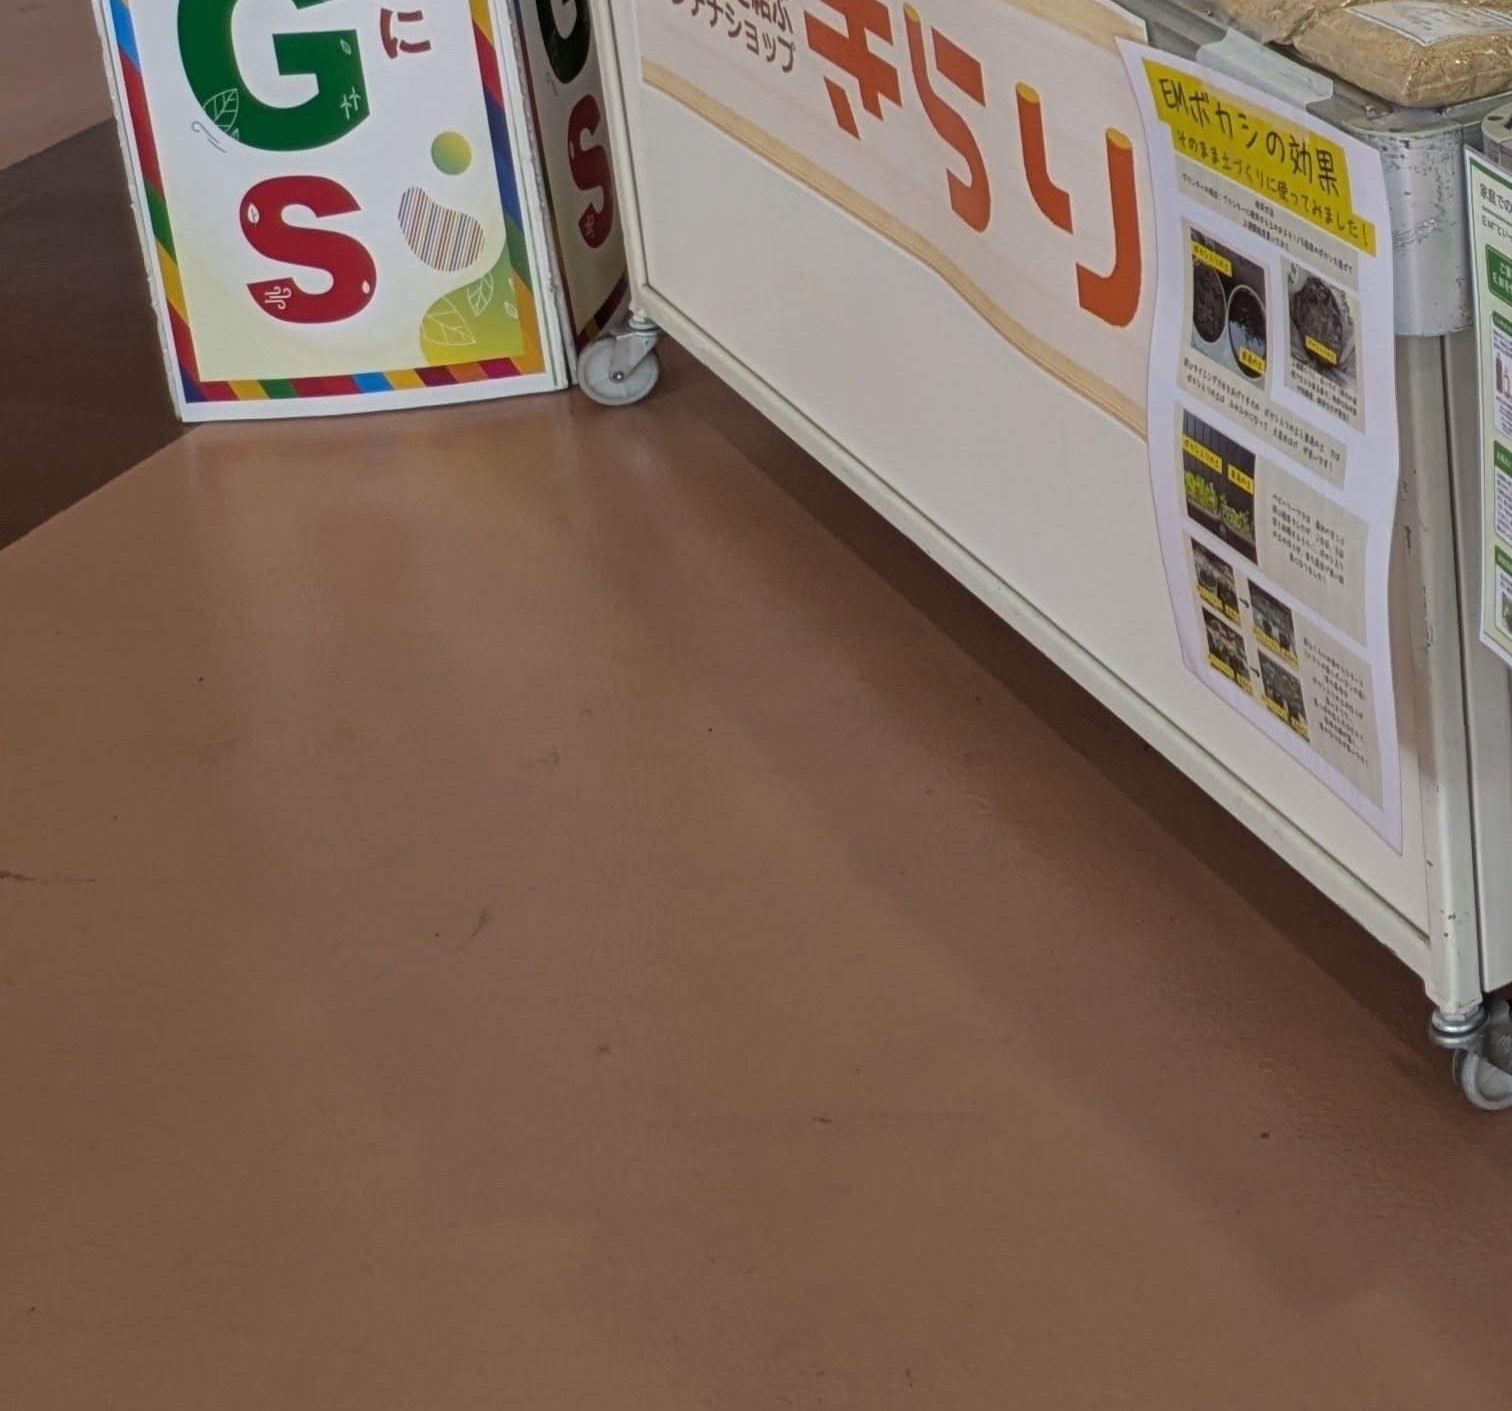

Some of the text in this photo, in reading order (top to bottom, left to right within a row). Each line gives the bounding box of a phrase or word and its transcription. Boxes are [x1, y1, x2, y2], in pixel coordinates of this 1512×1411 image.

[1158, 78, 1340, 197] EMボカシの効果
